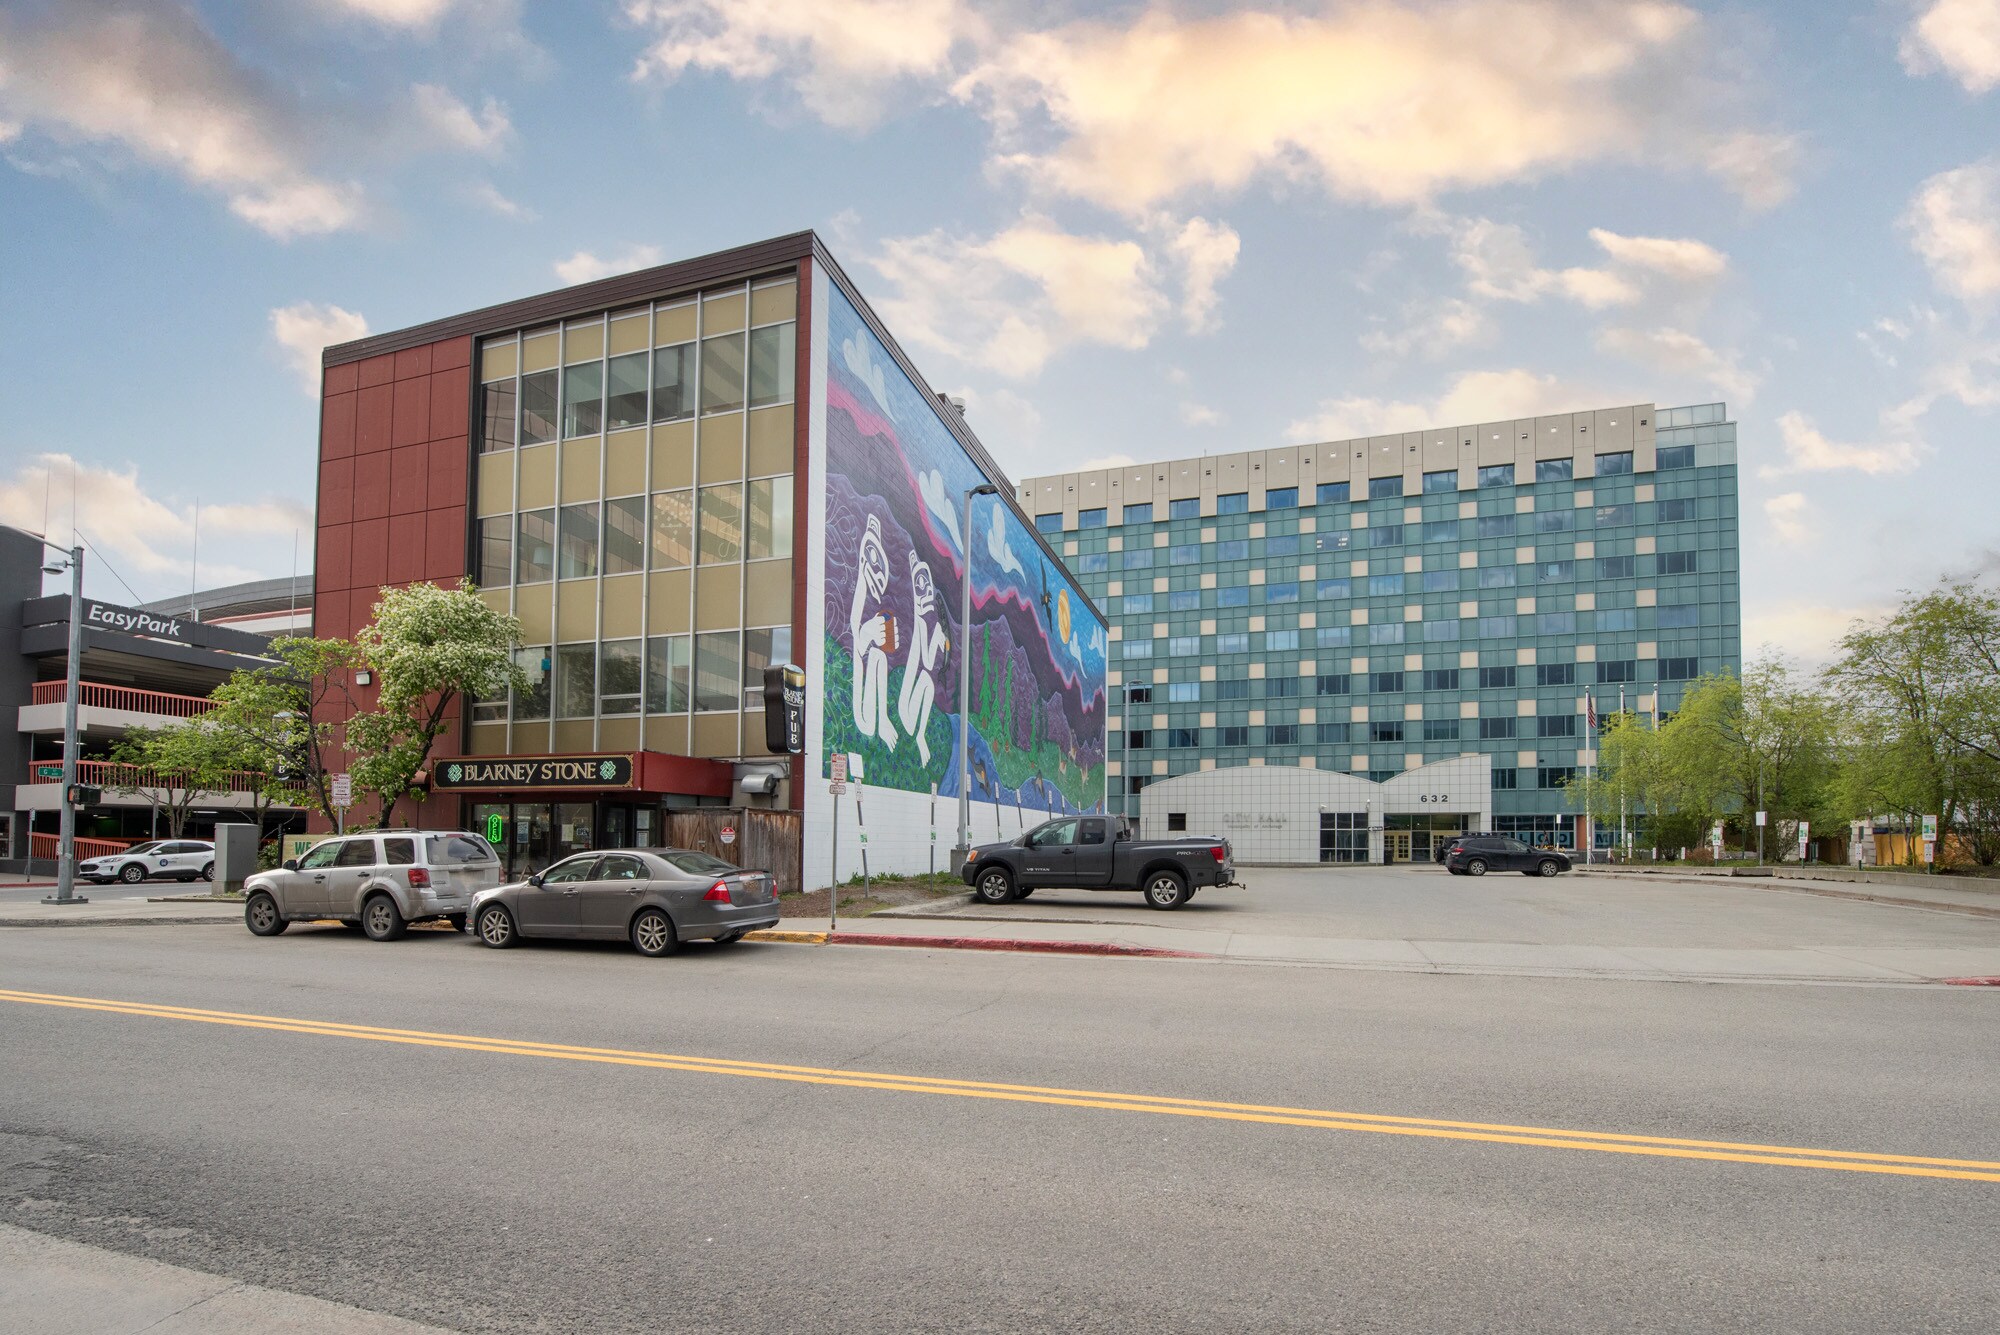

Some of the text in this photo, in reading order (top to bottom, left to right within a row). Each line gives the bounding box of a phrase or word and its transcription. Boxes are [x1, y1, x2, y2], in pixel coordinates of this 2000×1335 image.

[89, 604, 180, 636] EasyPark
[790, 710, 798, 744] PUB
[464, 761, 597, 784] BLARNEY STONE
